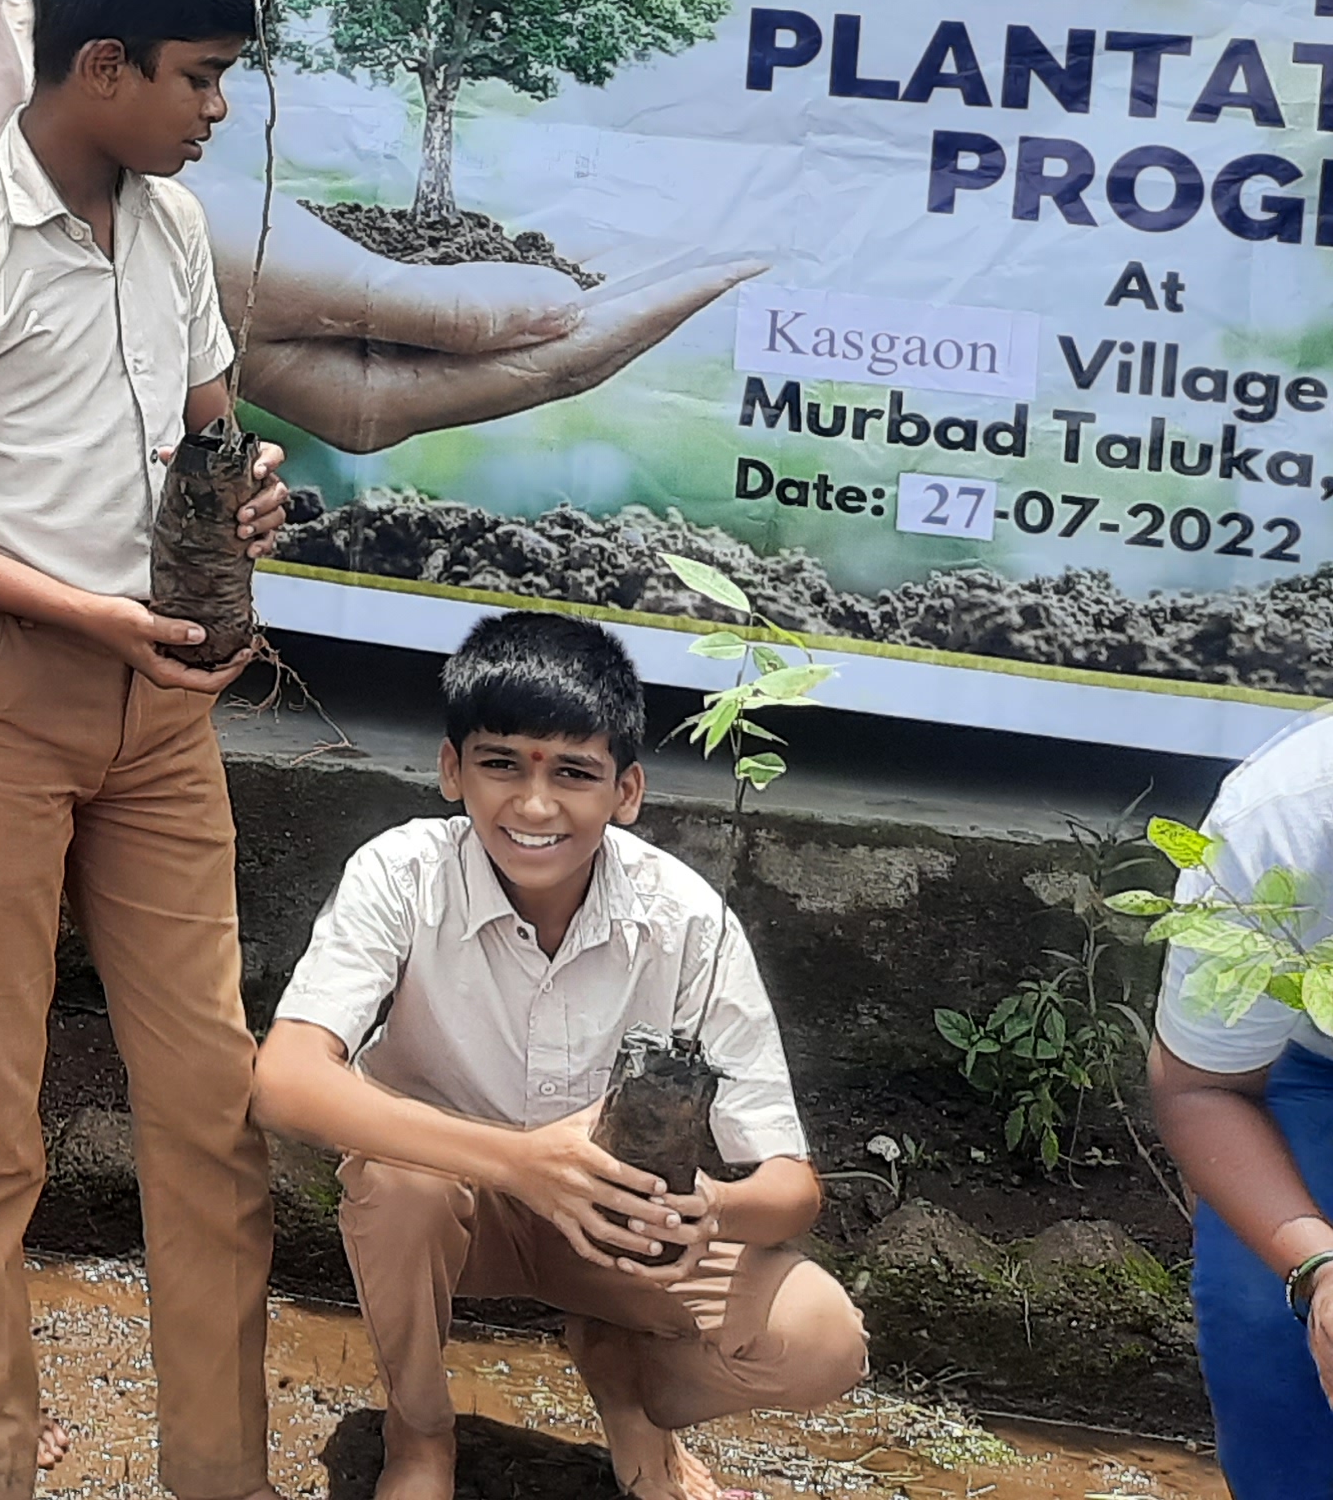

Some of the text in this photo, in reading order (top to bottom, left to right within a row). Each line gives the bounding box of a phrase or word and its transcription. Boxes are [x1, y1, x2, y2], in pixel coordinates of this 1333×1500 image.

[927, 129, 1333, 248] PROG
[1103, 260, 1186, 314] At
[762, 307, 1328, 423] Kasgaon Village
[734, 456, 886, 518] Date:
[738, 375, 1333, 501] Murbad Taluka,
